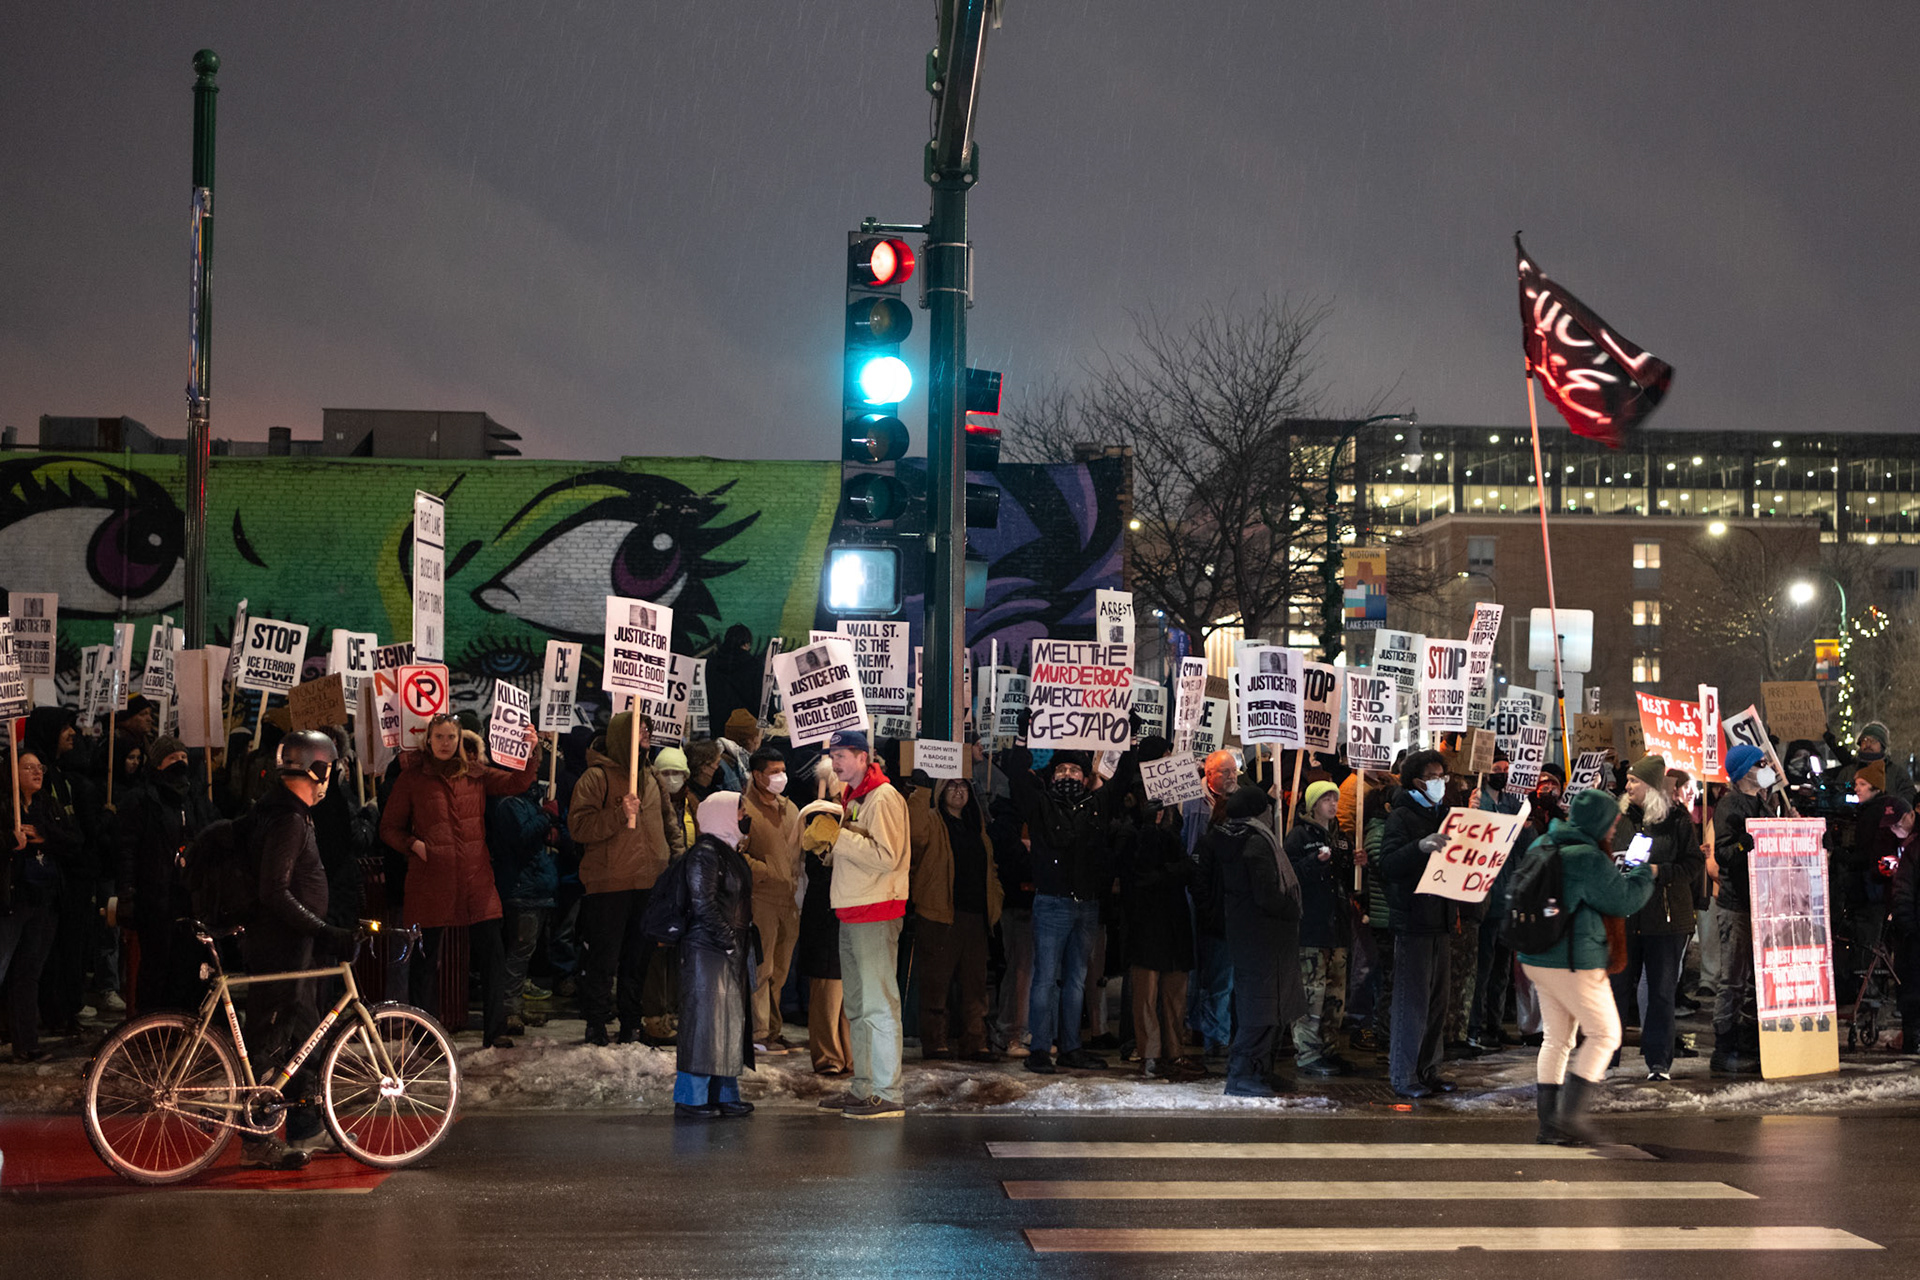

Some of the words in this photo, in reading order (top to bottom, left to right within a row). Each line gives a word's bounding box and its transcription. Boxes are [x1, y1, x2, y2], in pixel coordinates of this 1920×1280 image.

[1349, 550, 1380, 559] MIDTOWN
[419, 590, 430, 611] RIGHT
[1100, 601, 1132, 616] ARREST
[40, 619, 51, 633] FOR
[846, 624, 879, 638] WALL
[882, 624, 899, 638] ST.
[1346, 621, 1361, 630] LAKE
[1362, 620, 1385, 629] STREET
[252, 624, 301, 654] STOP
[614, 626, 650, 647] JUSTICE
[652, 633, 667, 651] FOR
[855, 639, 866, 652] IS
[870, 639, 890, 653] THE
[614, 648, 665, 668] RENEE
[1035, 642, 1087, 664] MELT
[1088, 644, 1128, 666] THE
[1379, 649, 1406, 662] JUSTICE
[1406, 652, 1417, 663] FOR
[1428, 646, 1467, 680] STOP
[247, 656, 261, 668] ICE
[263, 657, 296, 674] TERROR
[613, 660, 644, 678] NICOLE
[645, 666, 665, 683] GOOD
[1377, 664, 1415, 675] RENEE
[245, 668, 294, 683] NOW!
[789, 669, 830, 697] JUSTICE
[829, 664, 850, 683] FOR
[858, 670, 883, 685] NOT
[1033, 664, 1132, 687] MURDEROUS
[1248, 675, 1284, 692] JUSTICE
[1285, 677, 1297, 694] FOR
[1399, 675, 1414, 686] GOOD
[1303, 669, 1336, 704] TOP
[1350, 677, 1390, 700] TRUMP:
[497, 683, 528, 713] KILLER
[792, 689, 855, 713] RENEE
[1030, 685, 1132, 710] AMERIKKKAN
[1428, 689, 1436, 704] ICE
[1437, 690, 1464, 704] TERROR
[625, 696, 651, 715] FR
[654, 703, 676, 719] ALL
[794, 707, 831, 728] NICOLE
[830, 700, 858, 720] GOOD
[1155, 704, 1164, 715] FOR
[1248, 700, 1296, 713] RENEE
[1352, 699, 1384, 713] END
[1428, 706, 1462, 716] NOW!
[1680, 702, 1702, 720] IN
[1770, 702, 1784, 711] ICE
[494, 705, 530, 728] ICE
[886, 718, 896, 726] OUT
[1248, 712, 1279, 727] NICOLE
[1280, 713, 1297, 729] GOOD
[1349, 711, 1361, 721] THE
[1363, 713, 1392, 723] WAR
[492, 724, 509, 734] OFF
[1030, 709, 1129, 744] GESTAPO
[1351, 725, 1381, 744] ON
[1656, 718, 1699, 736] POWER
[490, 733, 529, 758] STREETS
[1200, 733, 1213, 742] OUR
[1520, 728, 1547, 746] KILLER
[920, 744, 942, 752] RACISM
[1518, 748, 1543, 762] ICE
[1144, 760, 1175, 779] ICE
[1175, 758, 1195, 767] WILL
[1146, 774, 1178, 795] KNOW
[1179, 772, 1194, 781] THE
[1174, 778, 1201, 793] TORTURE
[1163, 795, 1175, 806] HEY
[1178, 788, 1204, 801] INFLICT
[1758, 837, 1778, 853] FUCK
[1779, 837, 1791, 853] ICE
[1792, 836, 1817, 852] THUGS
[1446, 845, 1506, 868] CHOKE
[1432, 869, 1446, 883] a
[230, 1012, 243, 1050] Bianchi
[294, 1020, 331, 1066] Bianchi
